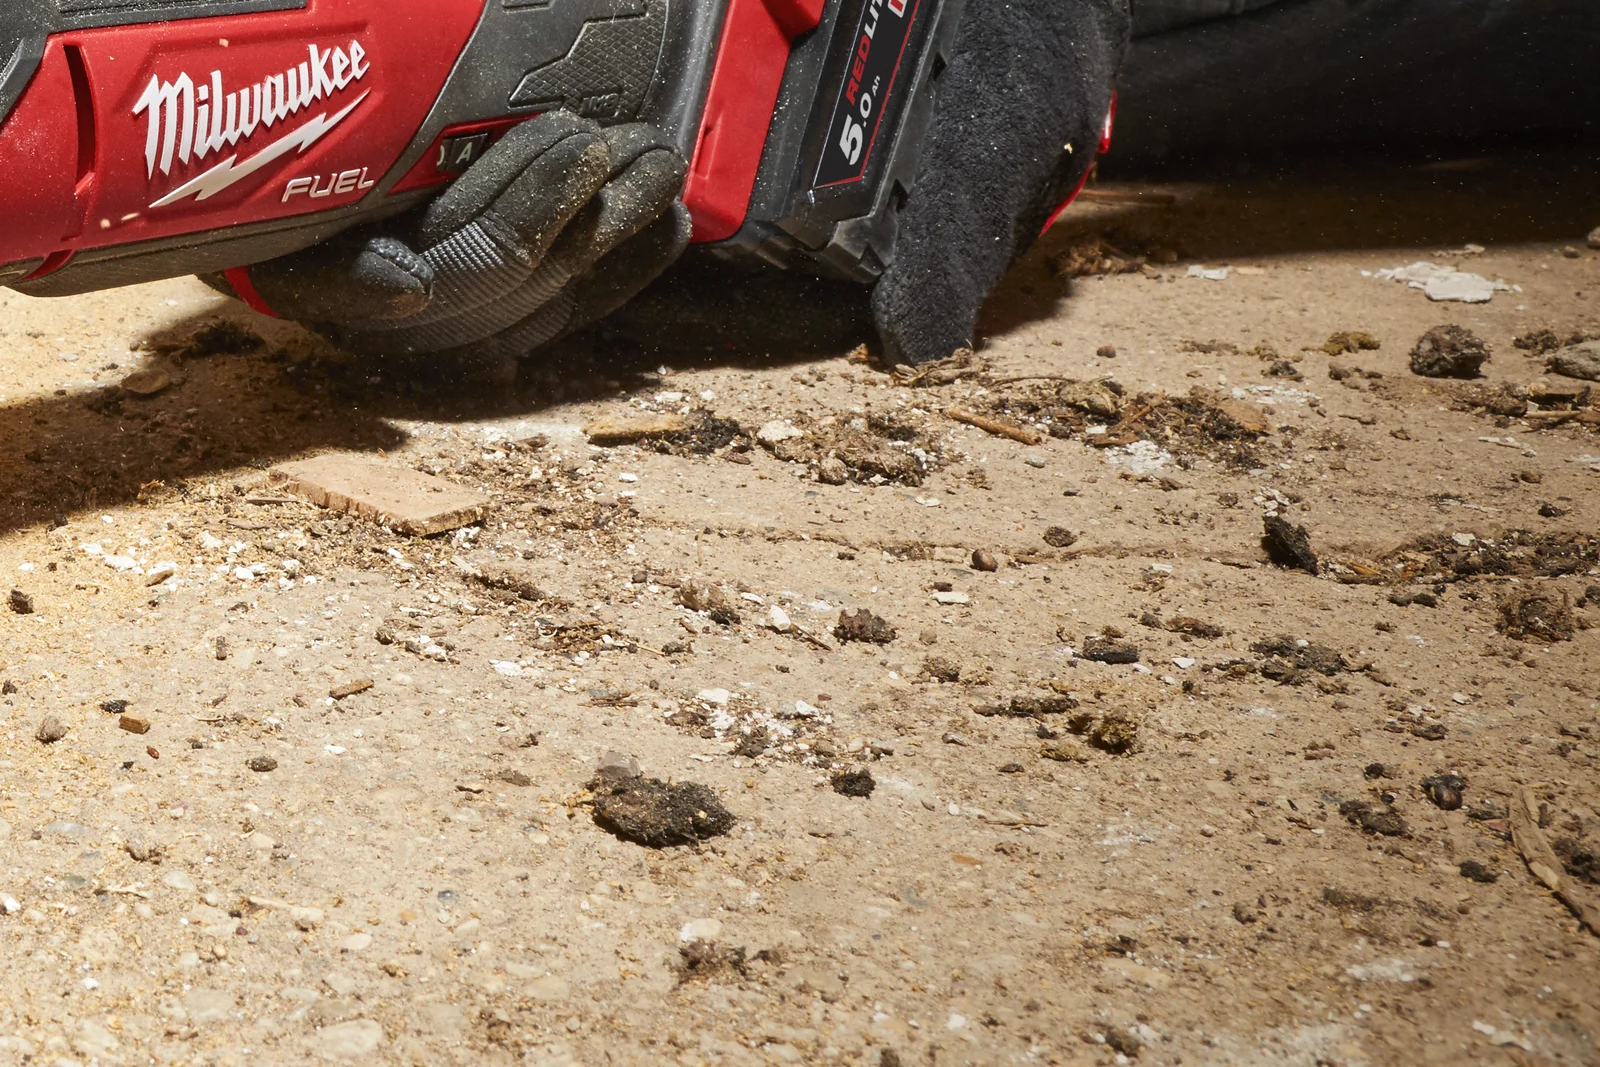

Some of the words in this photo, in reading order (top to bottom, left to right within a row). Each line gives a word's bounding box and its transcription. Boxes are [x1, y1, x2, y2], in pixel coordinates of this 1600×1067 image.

[132, 39, 370, 181] Milwaukee
[839, 92, 872, 165] 5.0
[455, 141, 473, 164] A
[281, 166, 375, 203] FUEL
